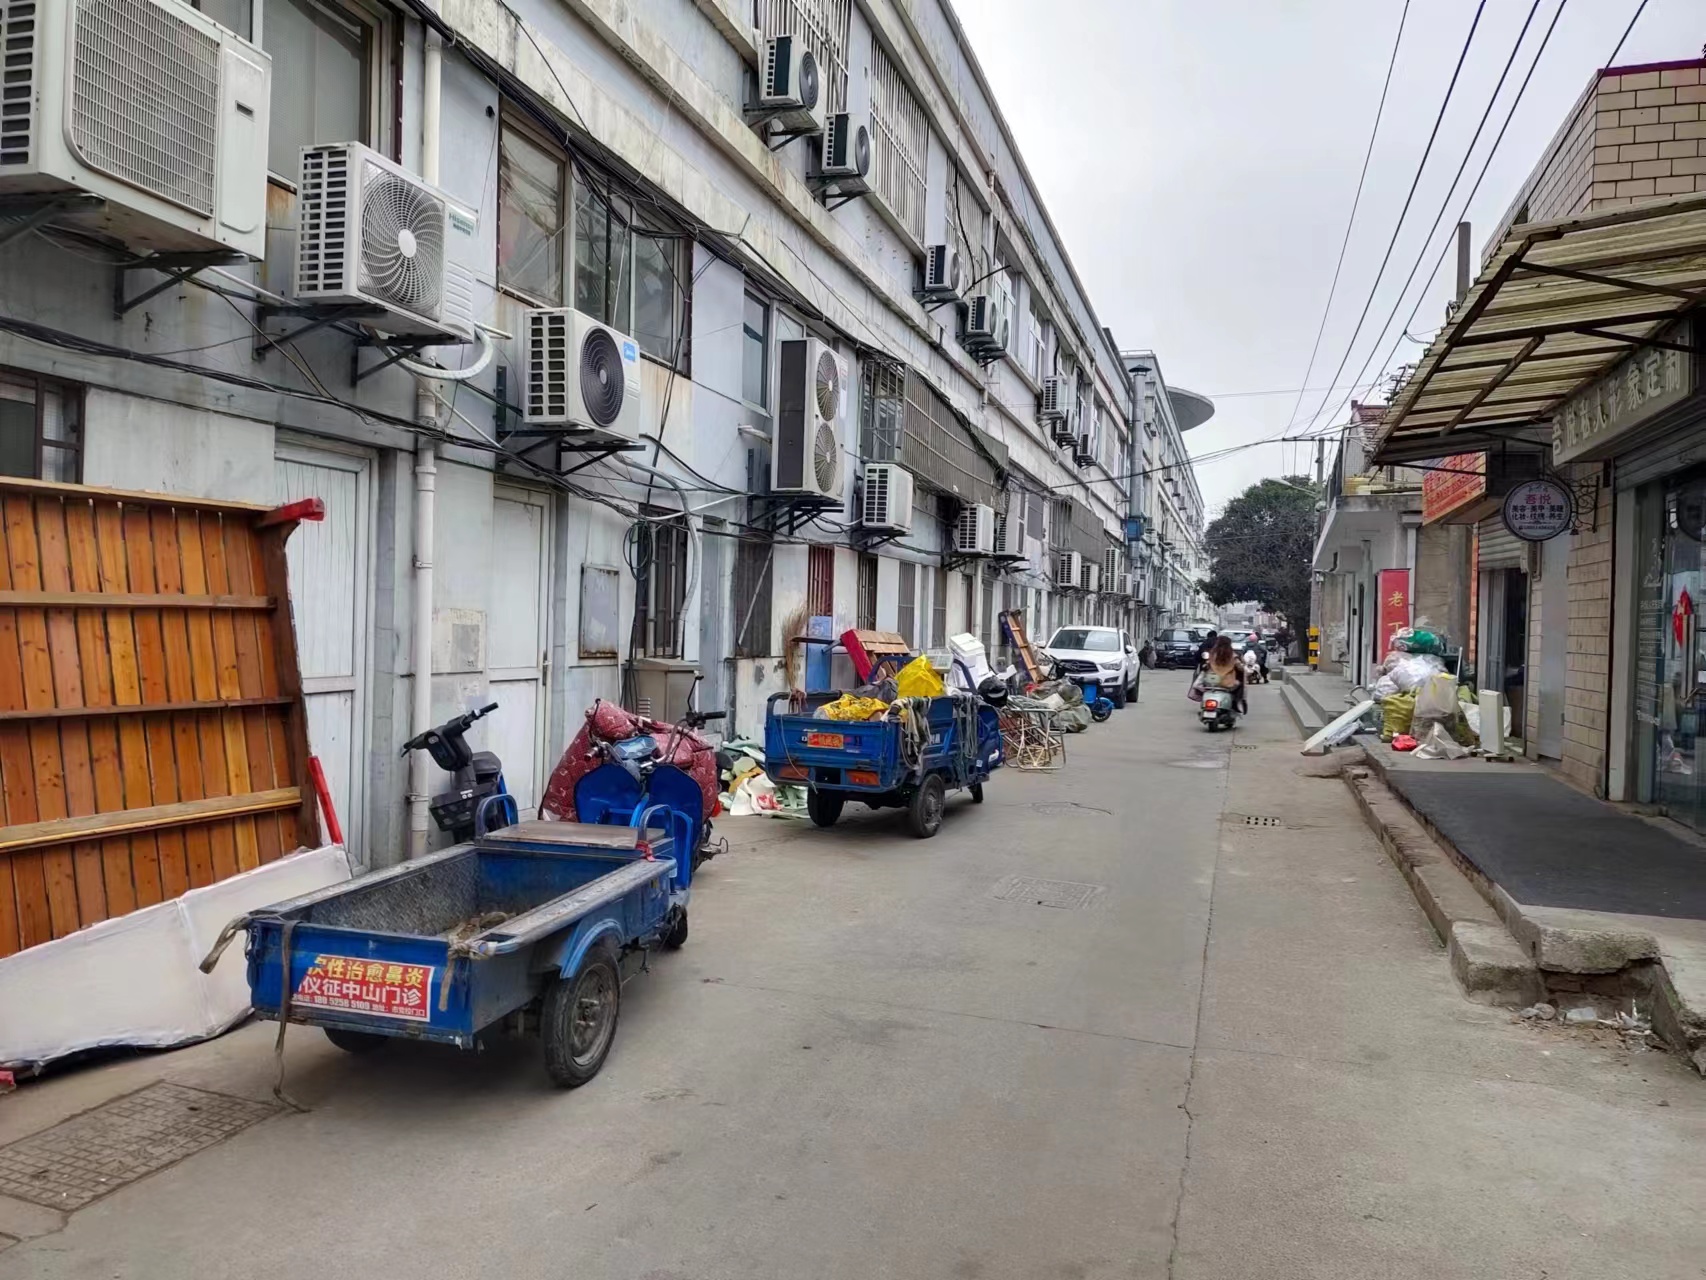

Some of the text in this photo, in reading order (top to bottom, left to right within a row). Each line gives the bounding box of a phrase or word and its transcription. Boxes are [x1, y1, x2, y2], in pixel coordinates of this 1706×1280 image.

[1552, 336, 1681, 456] 吾悦私人形象定制
[1525, 494, 1552, 505] 吾悦
[302, 976, 422, 1006] 仪征中山门诊
